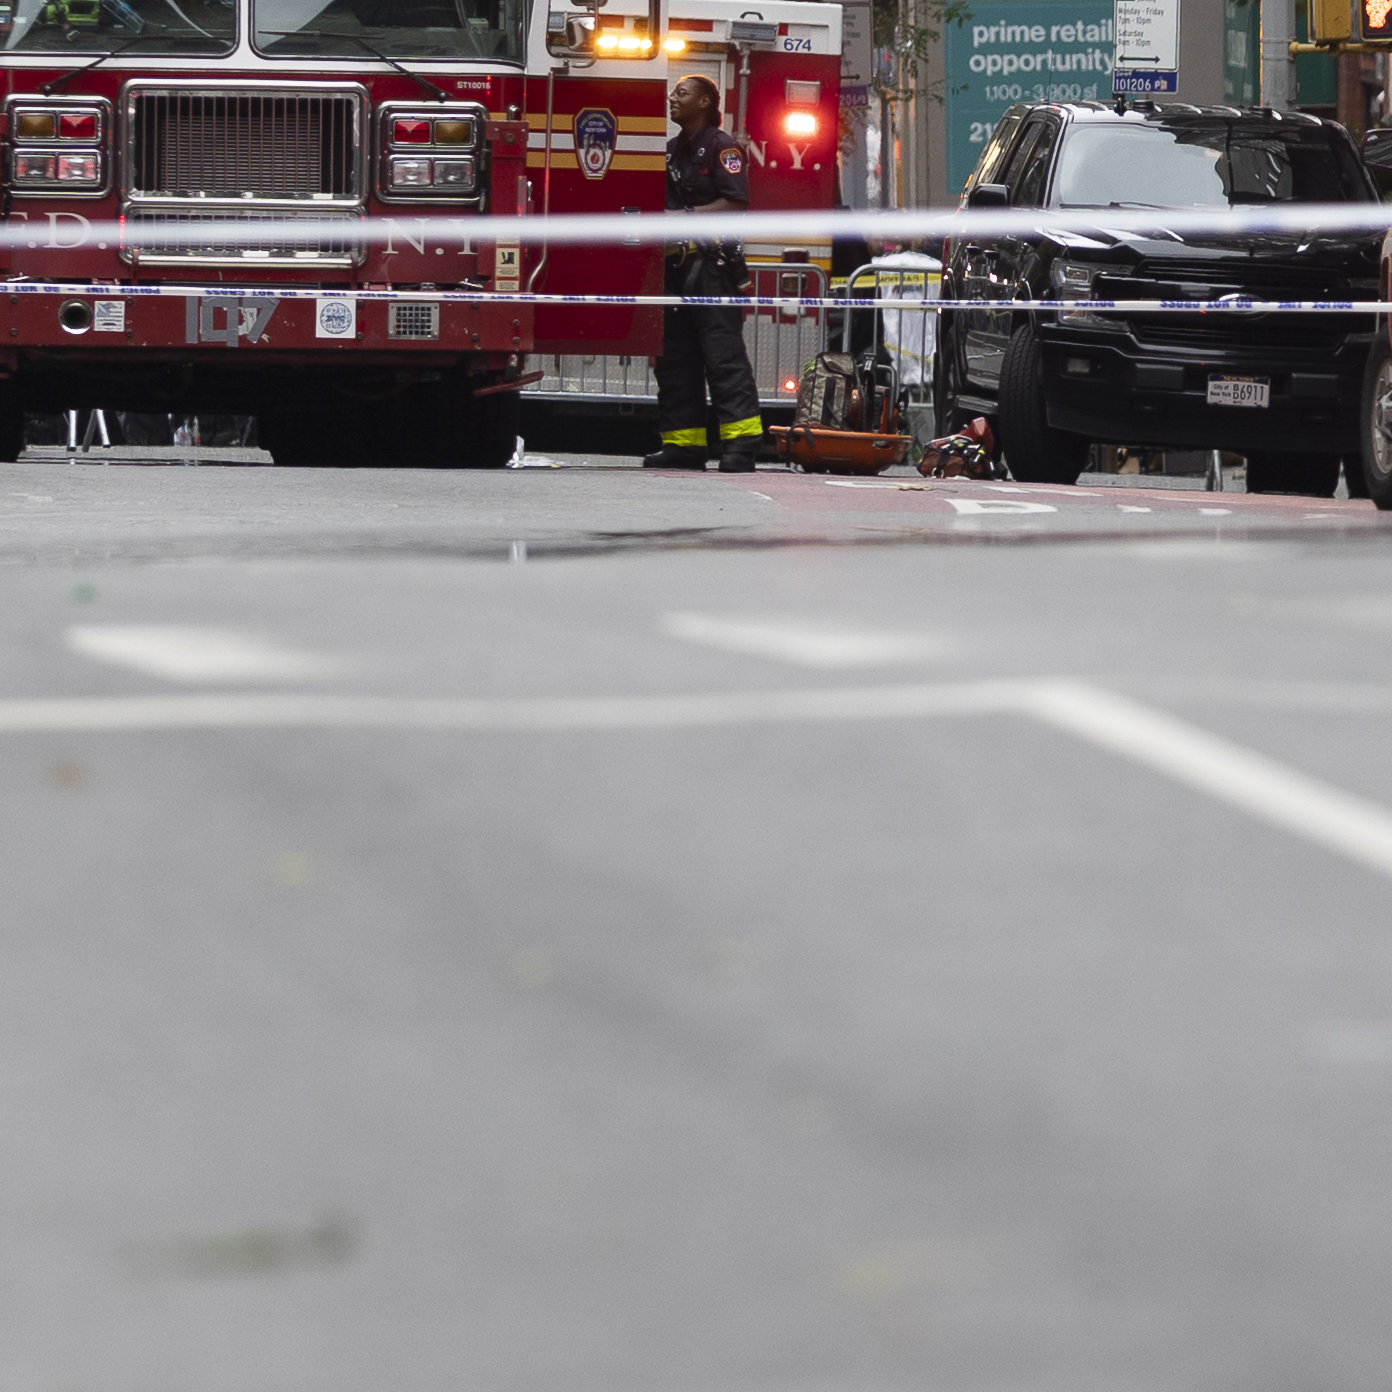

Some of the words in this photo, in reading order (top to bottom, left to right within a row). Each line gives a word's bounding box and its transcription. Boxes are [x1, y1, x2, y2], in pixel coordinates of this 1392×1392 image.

[1118, 7, 1141, 16] Monday
[1146, 7, 1164, 17] Friday
[972, 19, 1046, 48] prime
[1050, 18, 1112, 42] retail
[1118, 29, 1144, 39] Saturday
[783, 37, 813, 52] 674
[969, 47, 1114, 76] opportunity
[1115, 78, 1152, 91] 101206
[1240, 384, 1264, 401] 6911
